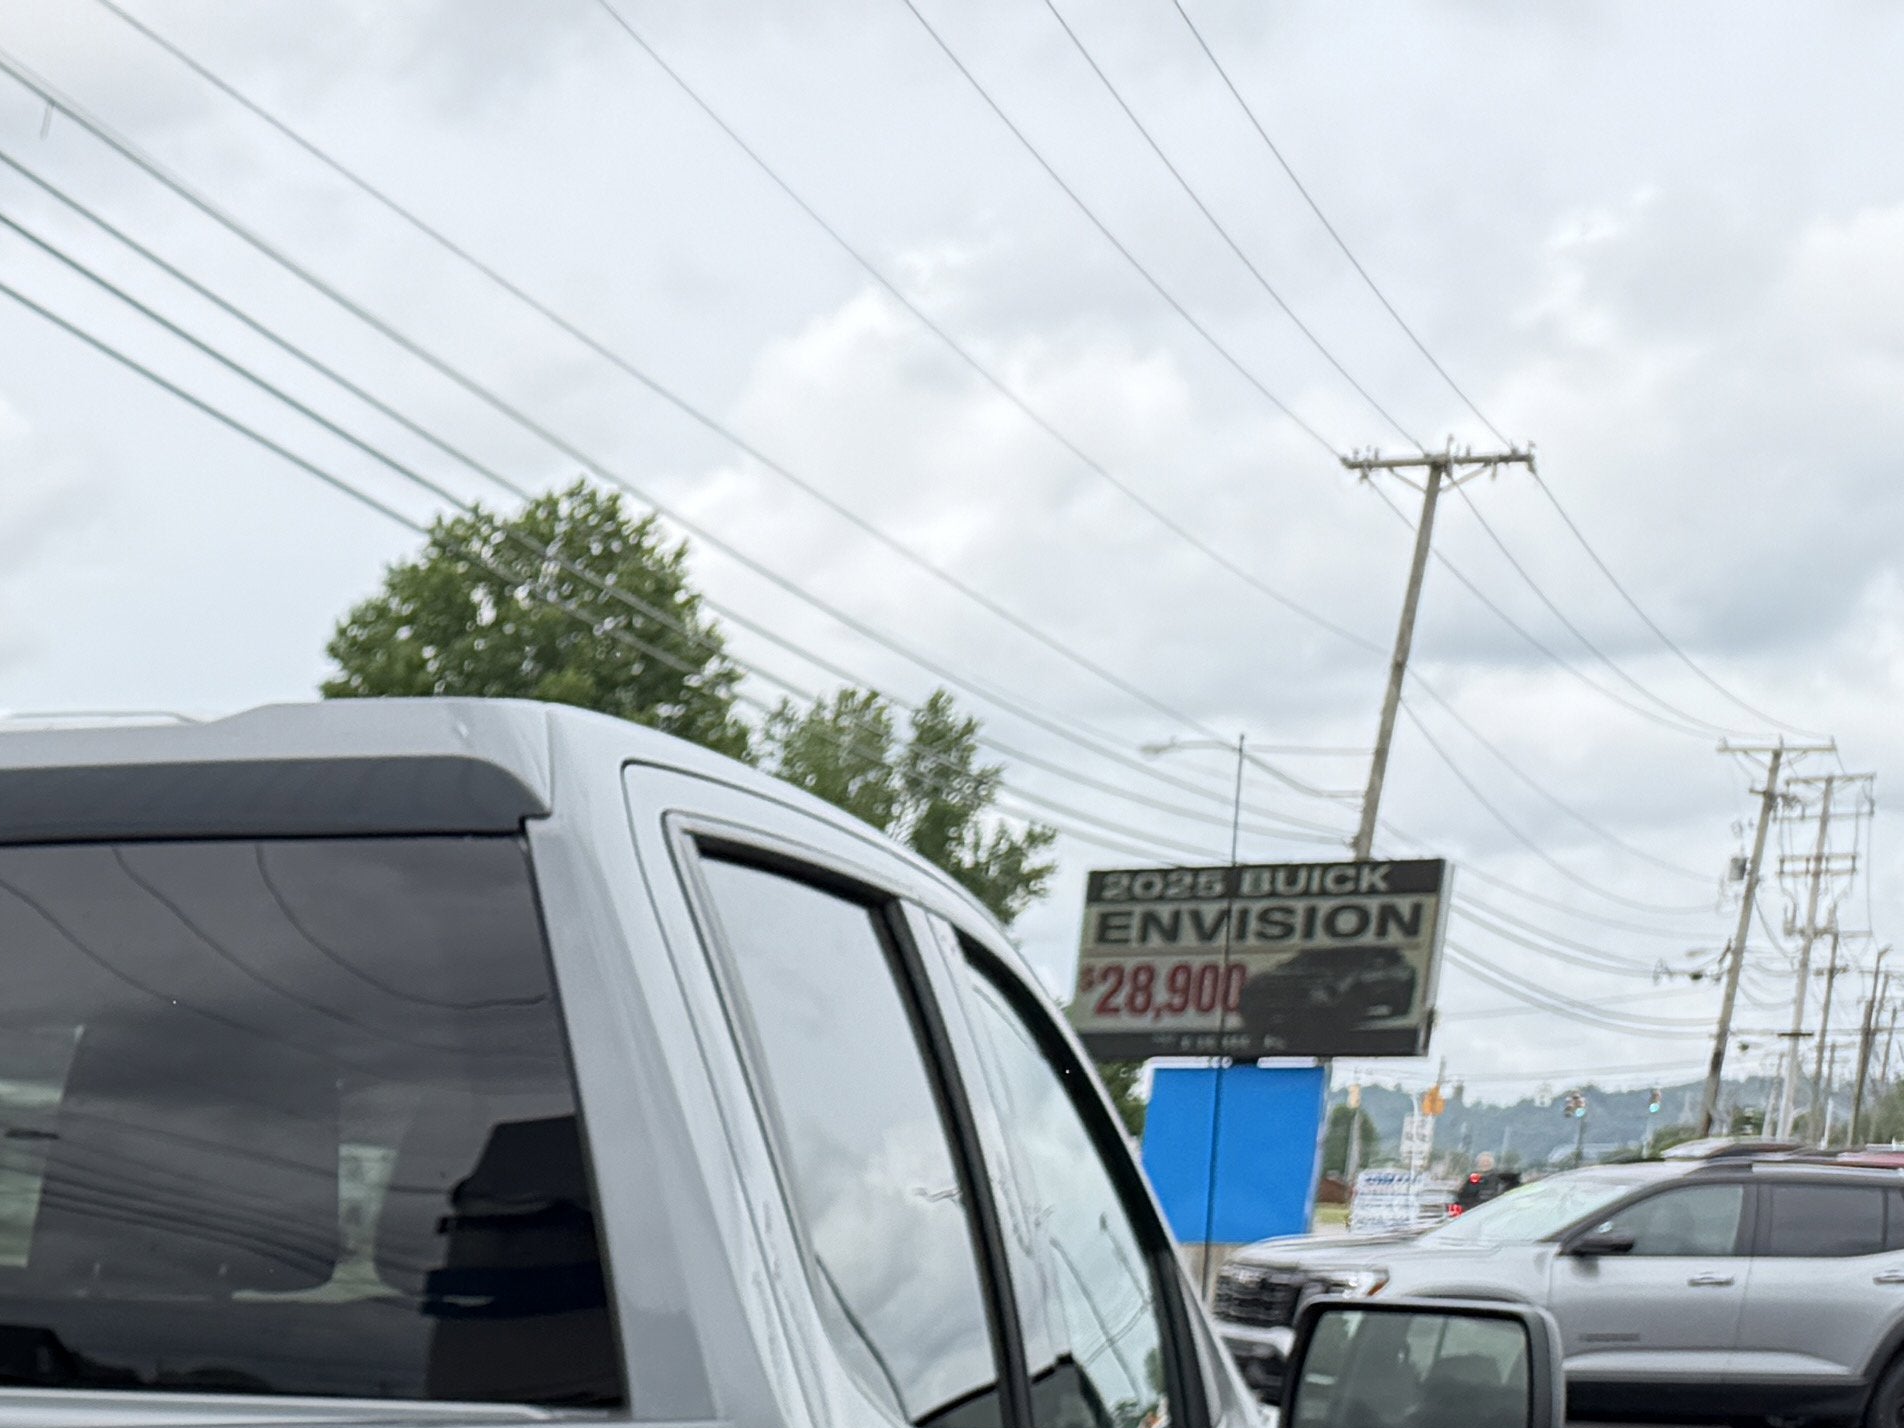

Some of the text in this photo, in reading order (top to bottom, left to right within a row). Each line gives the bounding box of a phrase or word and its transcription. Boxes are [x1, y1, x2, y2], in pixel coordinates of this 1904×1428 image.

[1100, 862, 1391, 900] 2025 BUICK
[1096, 903, 1422, 944] ENVISION
